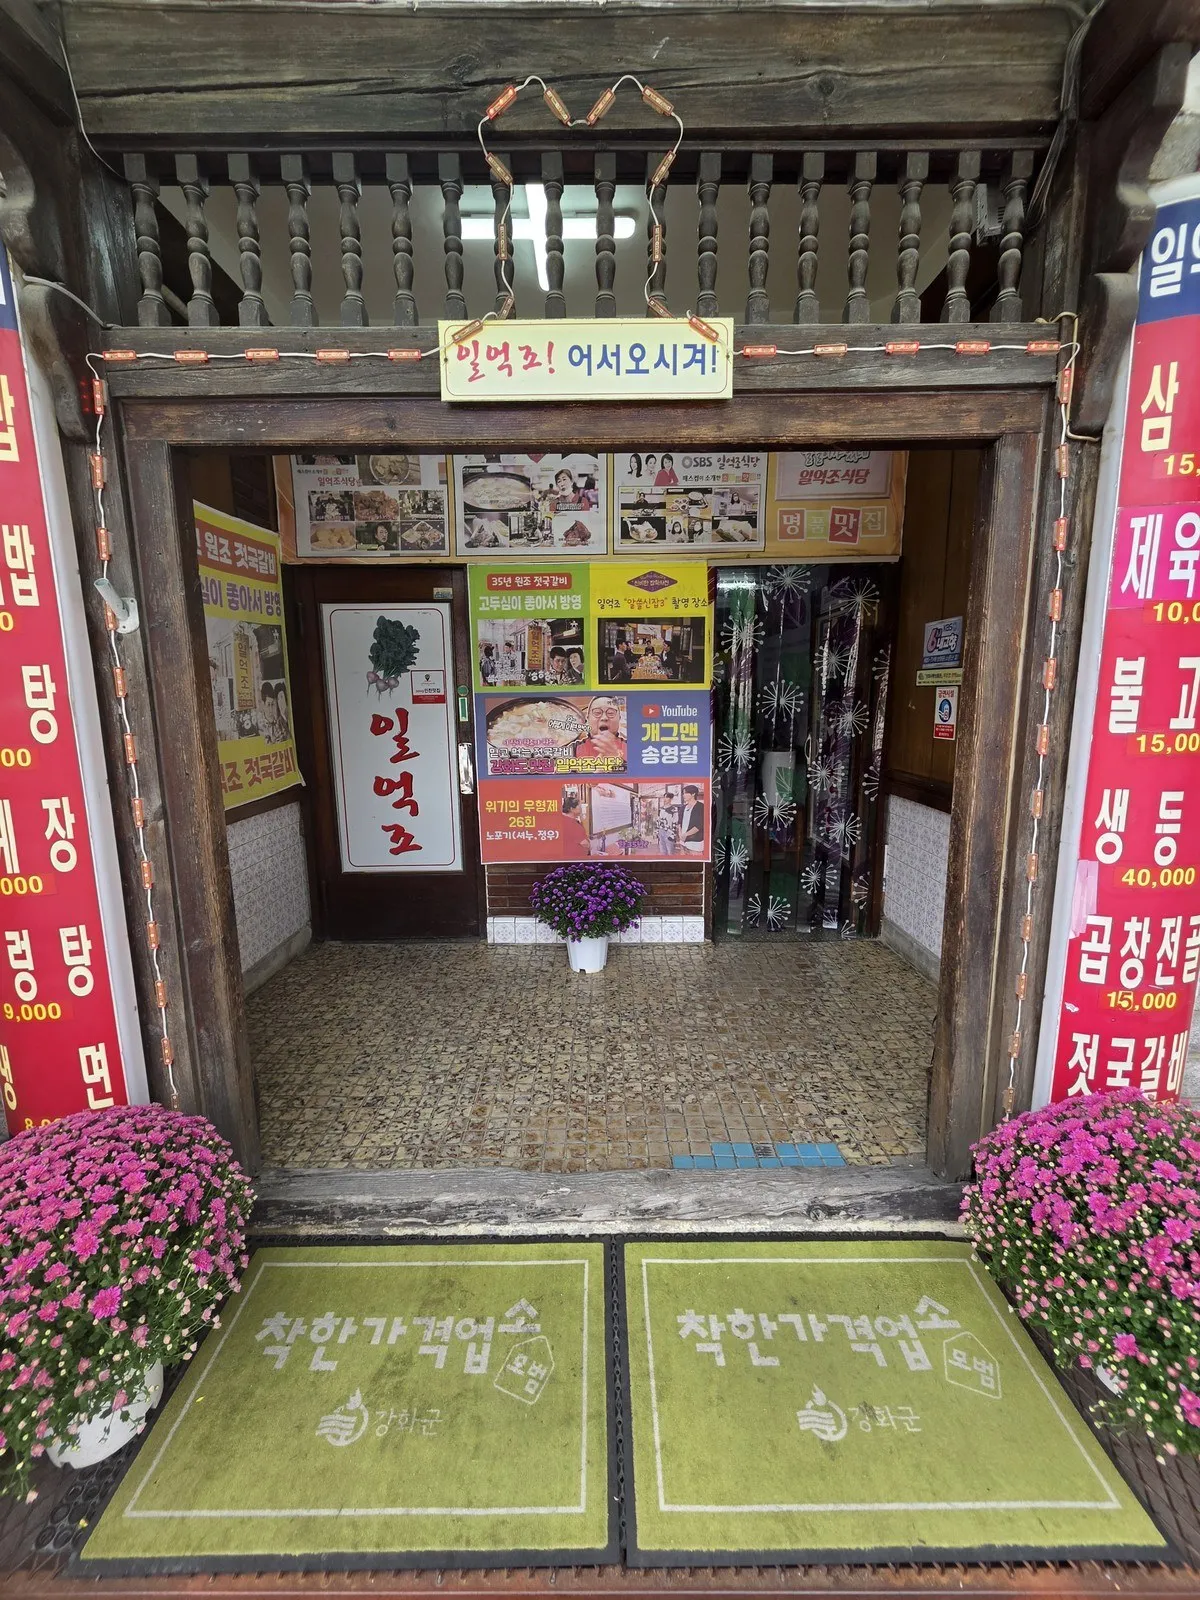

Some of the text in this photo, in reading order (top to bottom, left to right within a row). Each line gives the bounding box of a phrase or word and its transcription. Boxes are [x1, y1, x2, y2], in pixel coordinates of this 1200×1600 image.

[456, 340, 717, 383] 일억조! 어서오시겨!
[692, 454, 761, 470] SBS 일억조식당
[798, 468, 871, 486] 일억조식당
[204, 531, 233, 566] 원조
[233, 541, 277, 577] 젓국갈비
[491, 575, 568, 588] 35년 원조 젓국갈비
[479, 594, 583, 611] 고두심이 좋아서 방영
[597, 598, 621, 610] 일억조
[672, 597, 690, 610] 촬영
[692, 597, 708, 608] 장소
[661, 704, 698, 717] YouTube
[641, 722, 699, 742] 개그맨
[534, 747, 573, 758] 젓국갈비
[641, 745, 699, 765] 송영길
[244, 747, 297, 788] 젓국갈비
[370, 707, 423, 856] 일억조
[485, 799, 558, 813] 위기의 우형제
[508, 815, 536, 828] 26회
[1121, 867, 1196, 889] 40,000
[1107, 990, 1177, 1012] 15,000
[3, 1002, 62, 1022] 9,000
[254, 1297, 542, 1375] 착한가격업소
[676, 1295, 961, 1372] 착한가격업소
[948, 1348, 996, 1390] 모범
[374, 1407, 444, 1437] 강화군
[848, 1403, 922, 1433] 강화군
